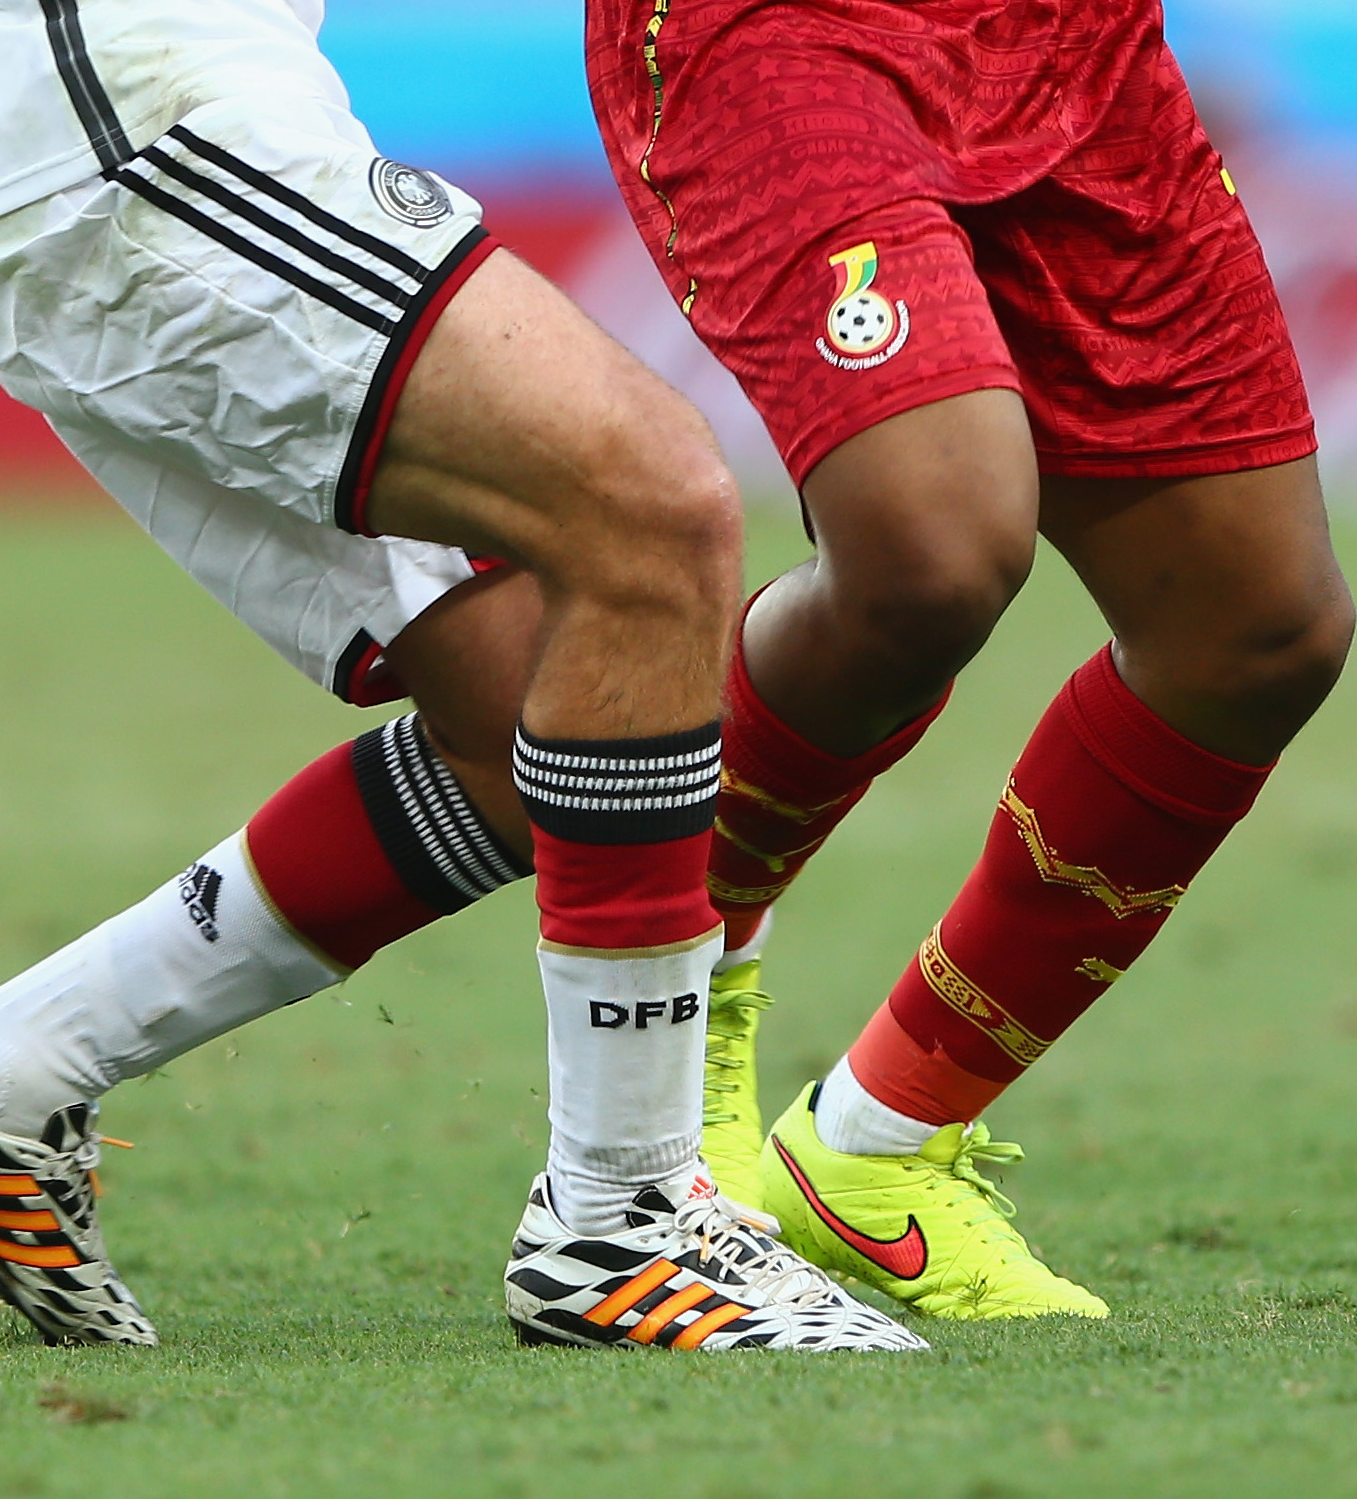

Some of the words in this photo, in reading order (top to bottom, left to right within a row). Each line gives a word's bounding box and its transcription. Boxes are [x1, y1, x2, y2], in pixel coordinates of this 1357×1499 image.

[815, 336, 840, 367] GHANA
[838, 351, 888, 371] FOOTBALL
[588, 992, 701, 1029] DFB
